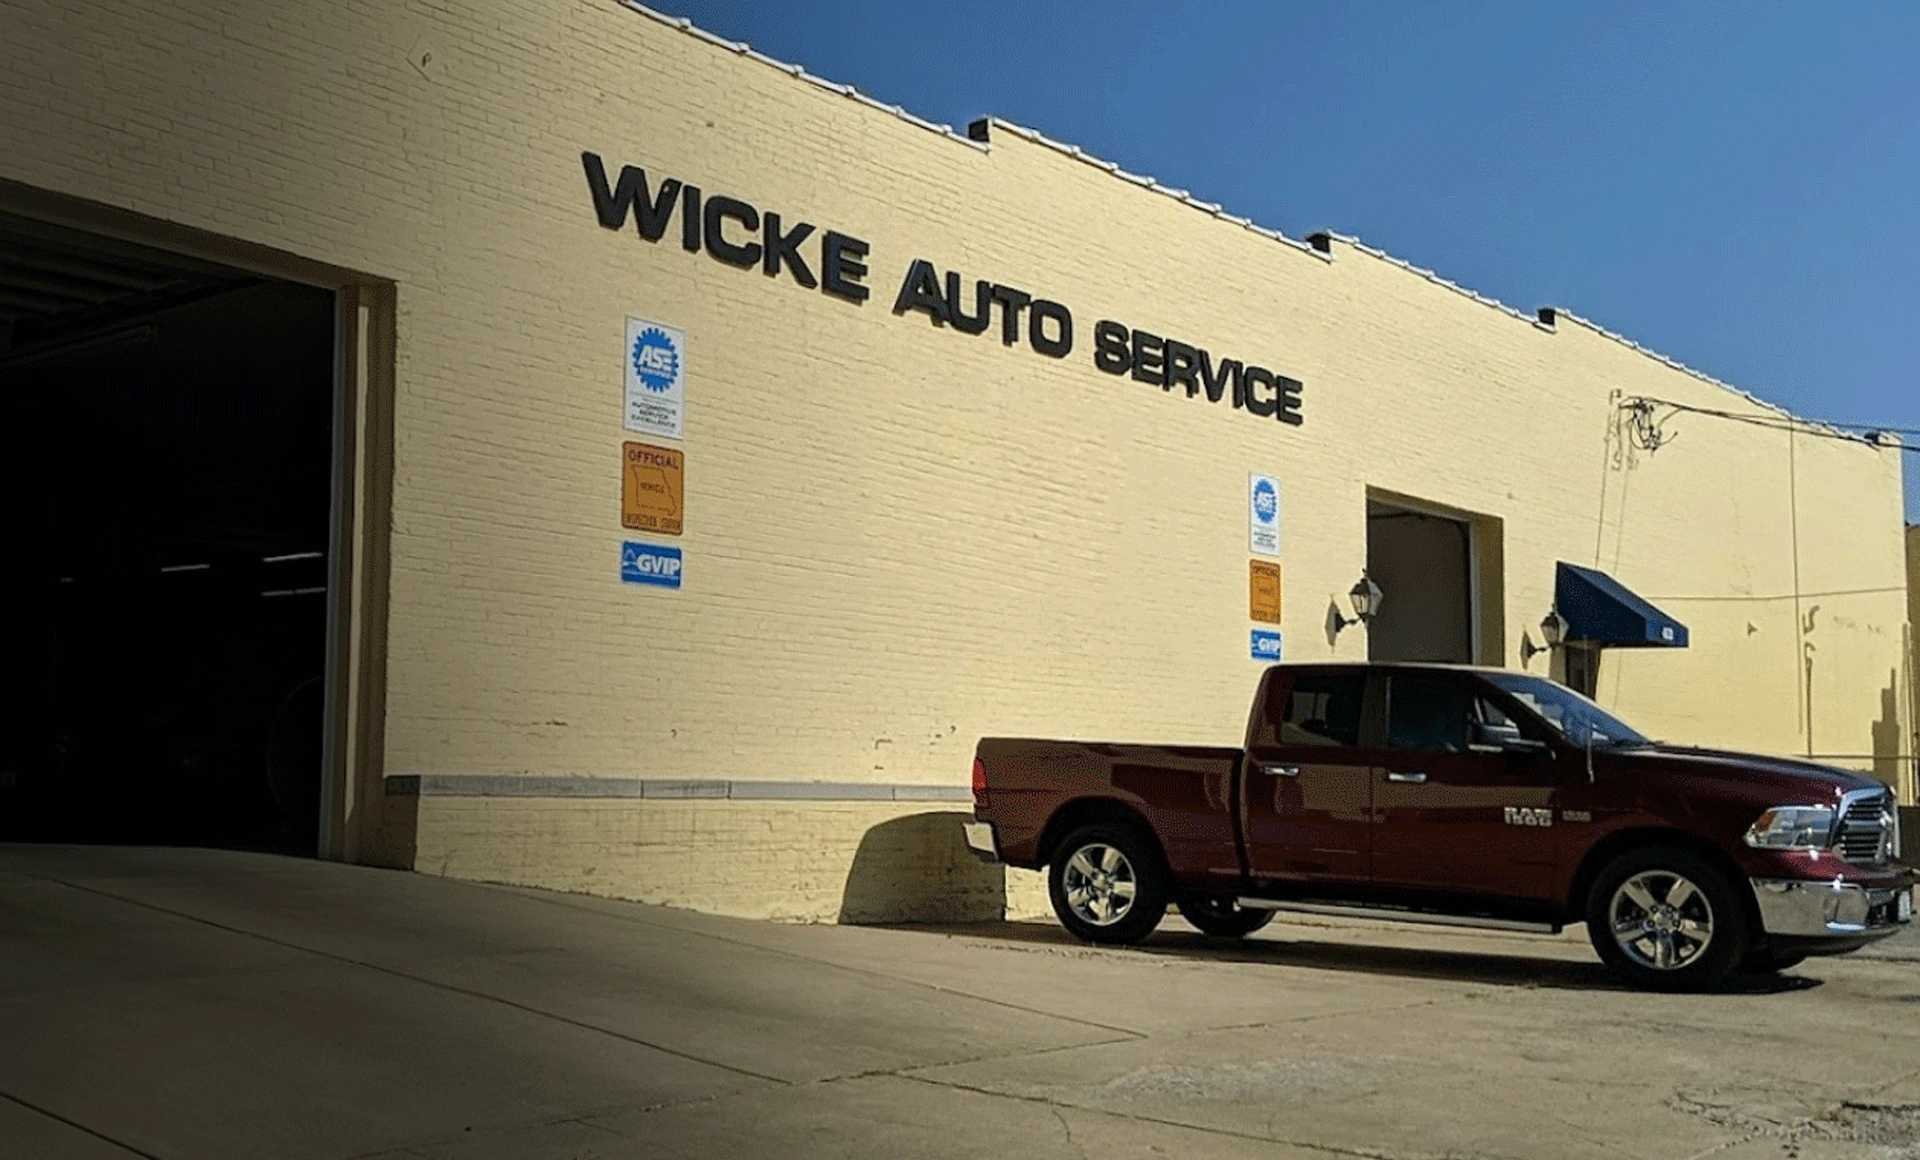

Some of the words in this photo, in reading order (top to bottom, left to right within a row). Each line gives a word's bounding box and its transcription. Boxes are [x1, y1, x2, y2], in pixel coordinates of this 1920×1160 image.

[581, 151, 869, 305] WICKE
[892, 259, 1073, 358] AUTO
[1095, 320, 1303, 426] SERVICE
[638, 344, 673, 371] ASE
[628, 450, 679, 470] OFFICIAL
[636, 553, 680, 575] GVIP
